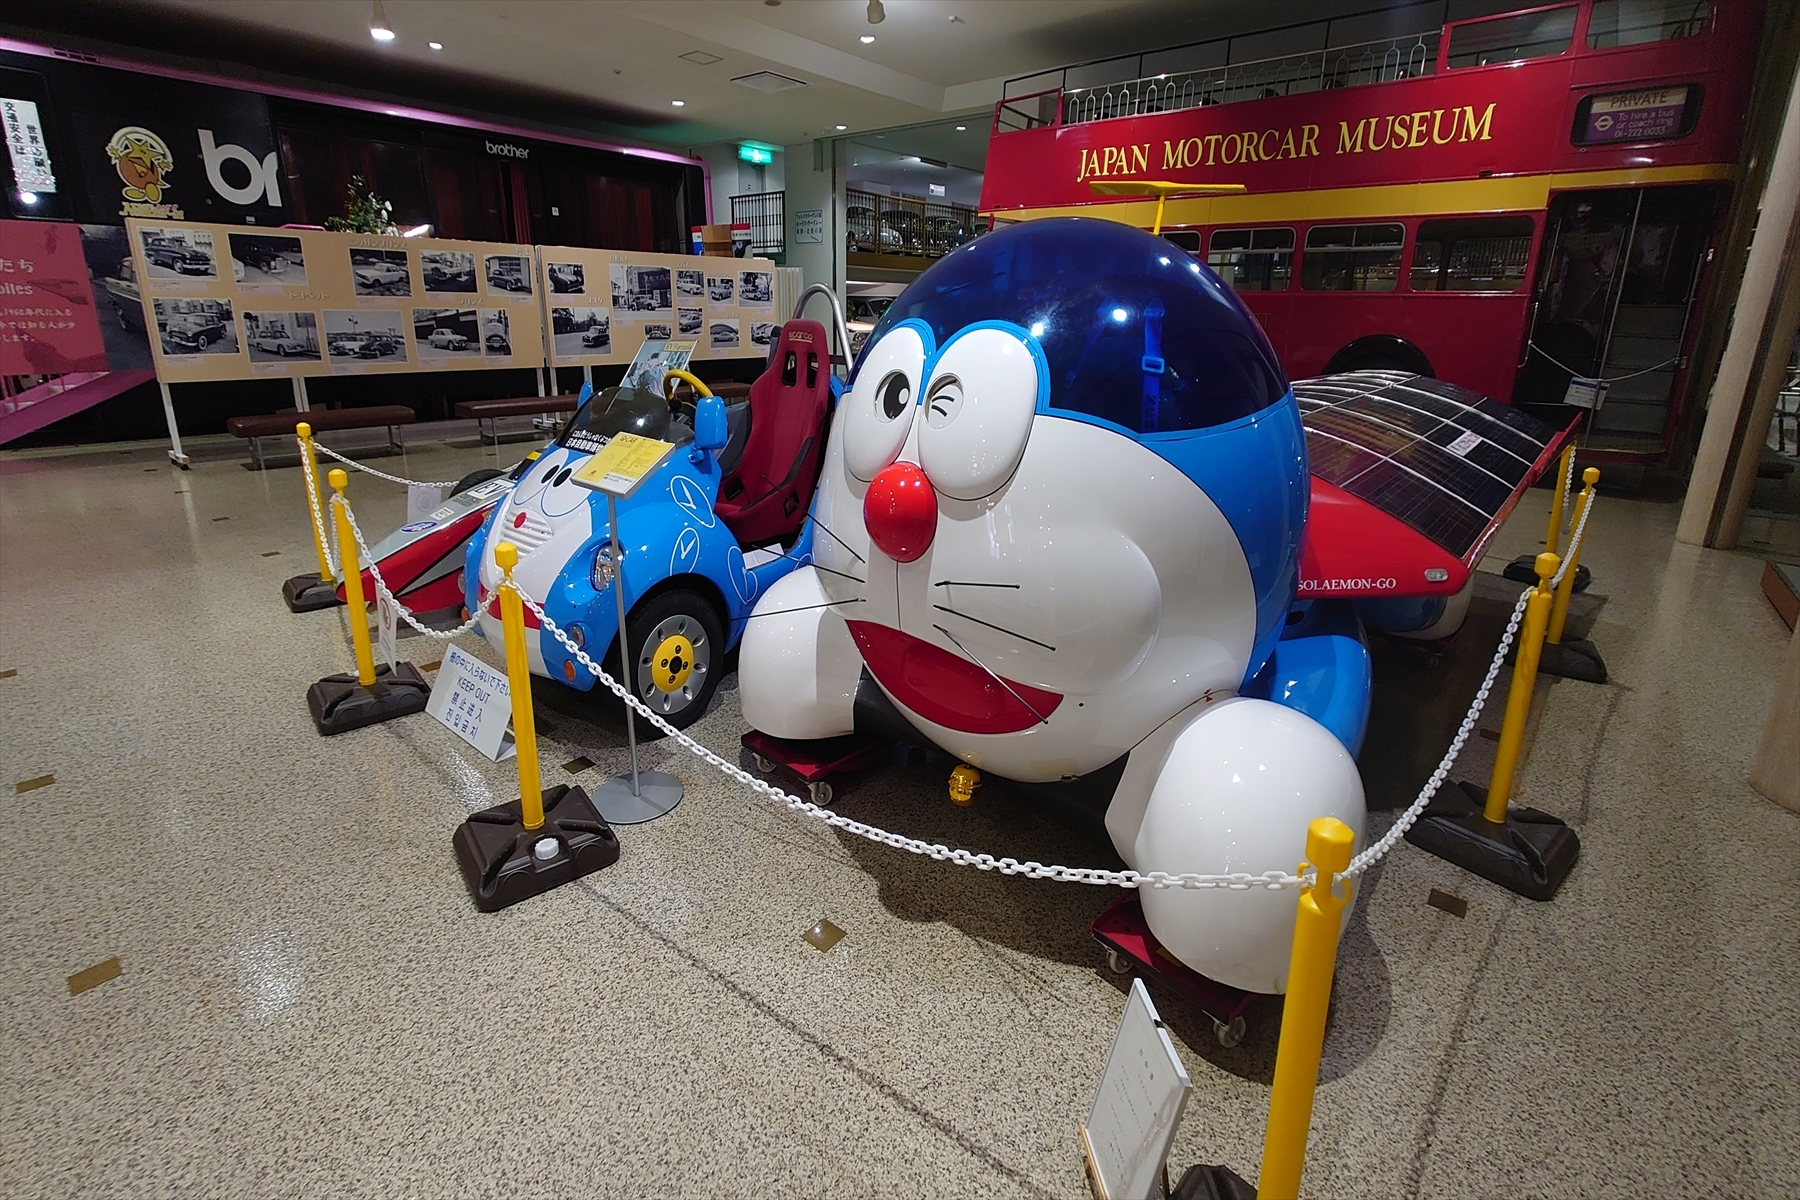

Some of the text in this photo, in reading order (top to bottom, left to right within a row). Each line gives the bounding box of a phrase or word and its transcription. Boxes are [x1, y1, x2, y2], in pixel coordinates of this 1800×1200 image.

[1611, 92, 1668, 108] PRIVATE
[1618, 112, 1628, 121] To
[1631, 111, 1648, 119] hire
[1628, 119, 1654, 127] coach
[1656, 117, 1674, 127] ring
[485, 140, 530, 160] brother
[1077, 103, 1498, 183] JAPAN MOTORCAR MUSEUM
[788, 330, 814, 341] sparco
[1298, 577, 1397, 591] SOLAEMON-GO
[457, 675, 491, 704] KEEP OUT
[446, 707, 479, 740] 진입금지
